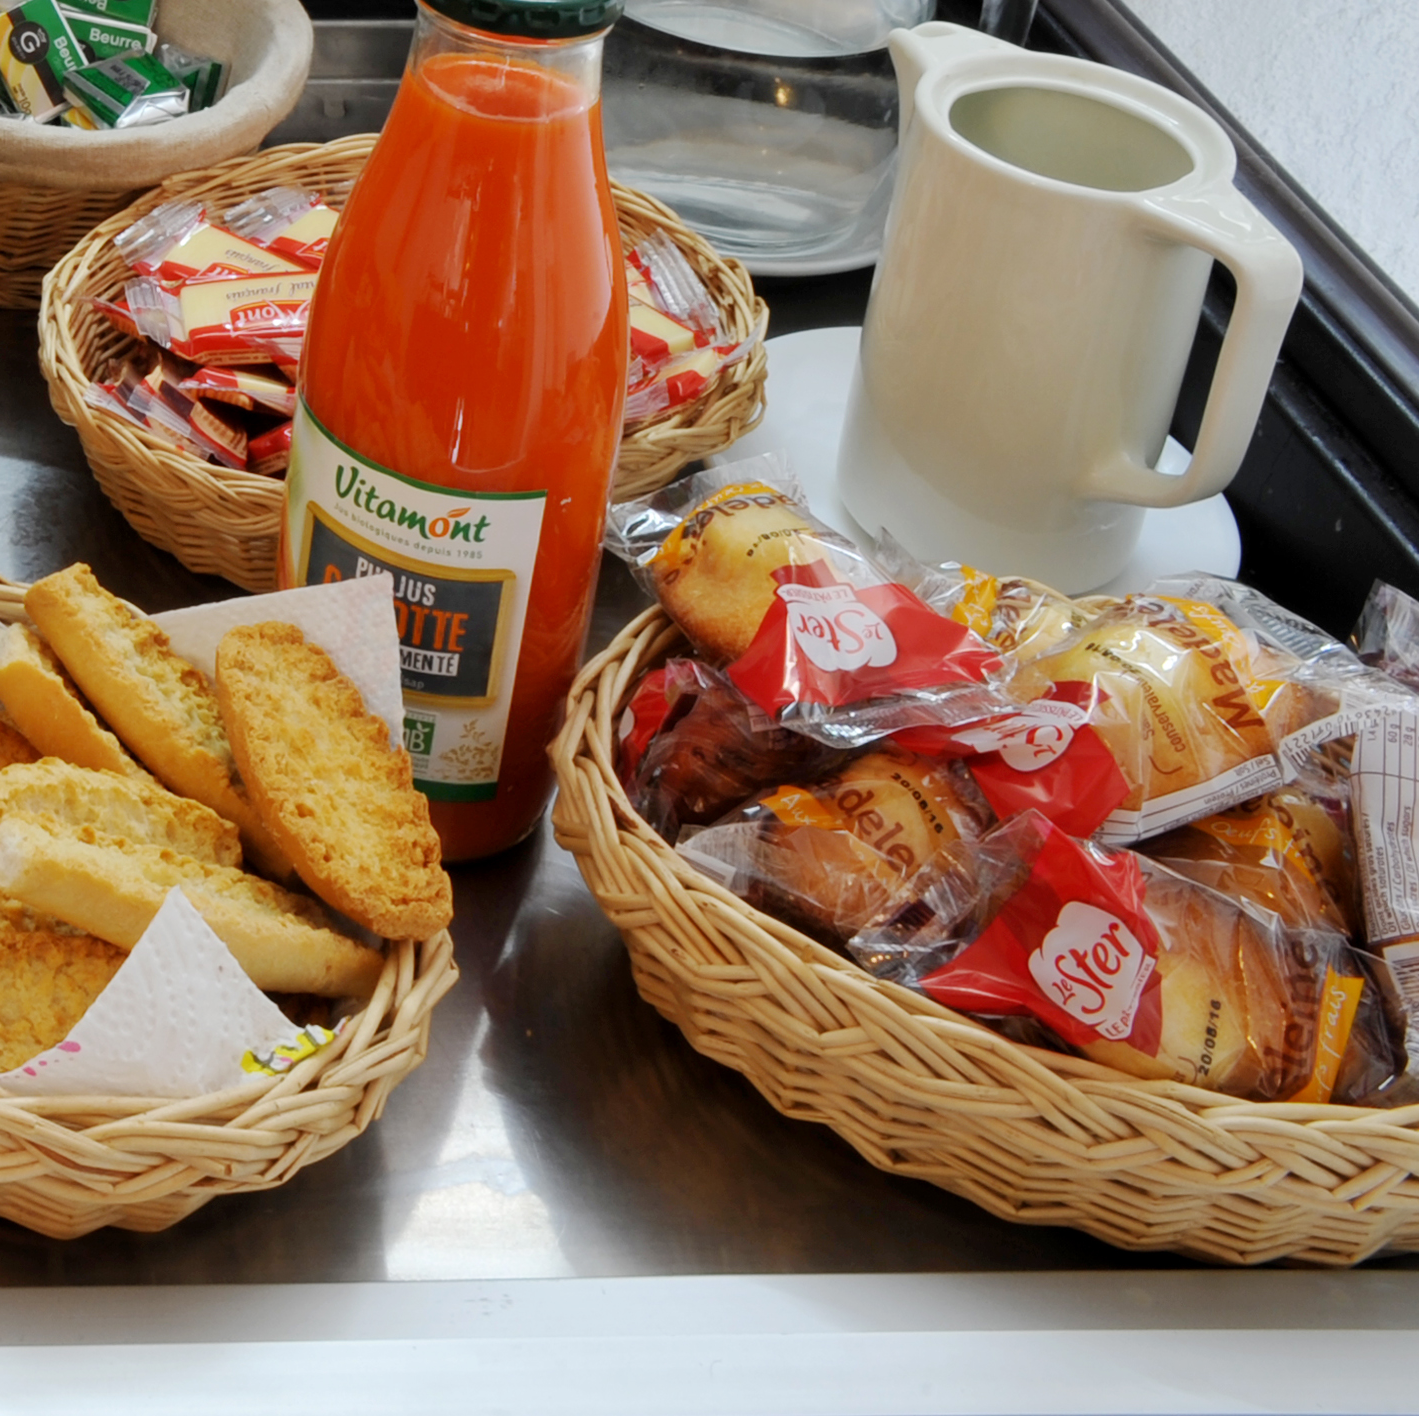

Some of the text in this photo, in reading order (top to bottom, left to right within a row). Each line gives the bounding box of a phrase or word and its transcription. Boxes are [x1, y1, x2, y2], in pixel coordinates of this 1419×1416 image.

[53, 35, 77, 72] Beur
[89, 27, 142, 50] Beurre
[225, 282, 283, 301] français
[334, 463, 492, 544] Vitamont
[332, 502, 484, 560] Jus biologiques depuis 1985
[394, 574, 437, 607] JUS
[796, 608, 884, 654] Le Ster
[399, 650, 458, 675] MENTÉ
[1051, 921, 1131, 1015] Le Ster
[1322, 986, 1347, 1060] frais
